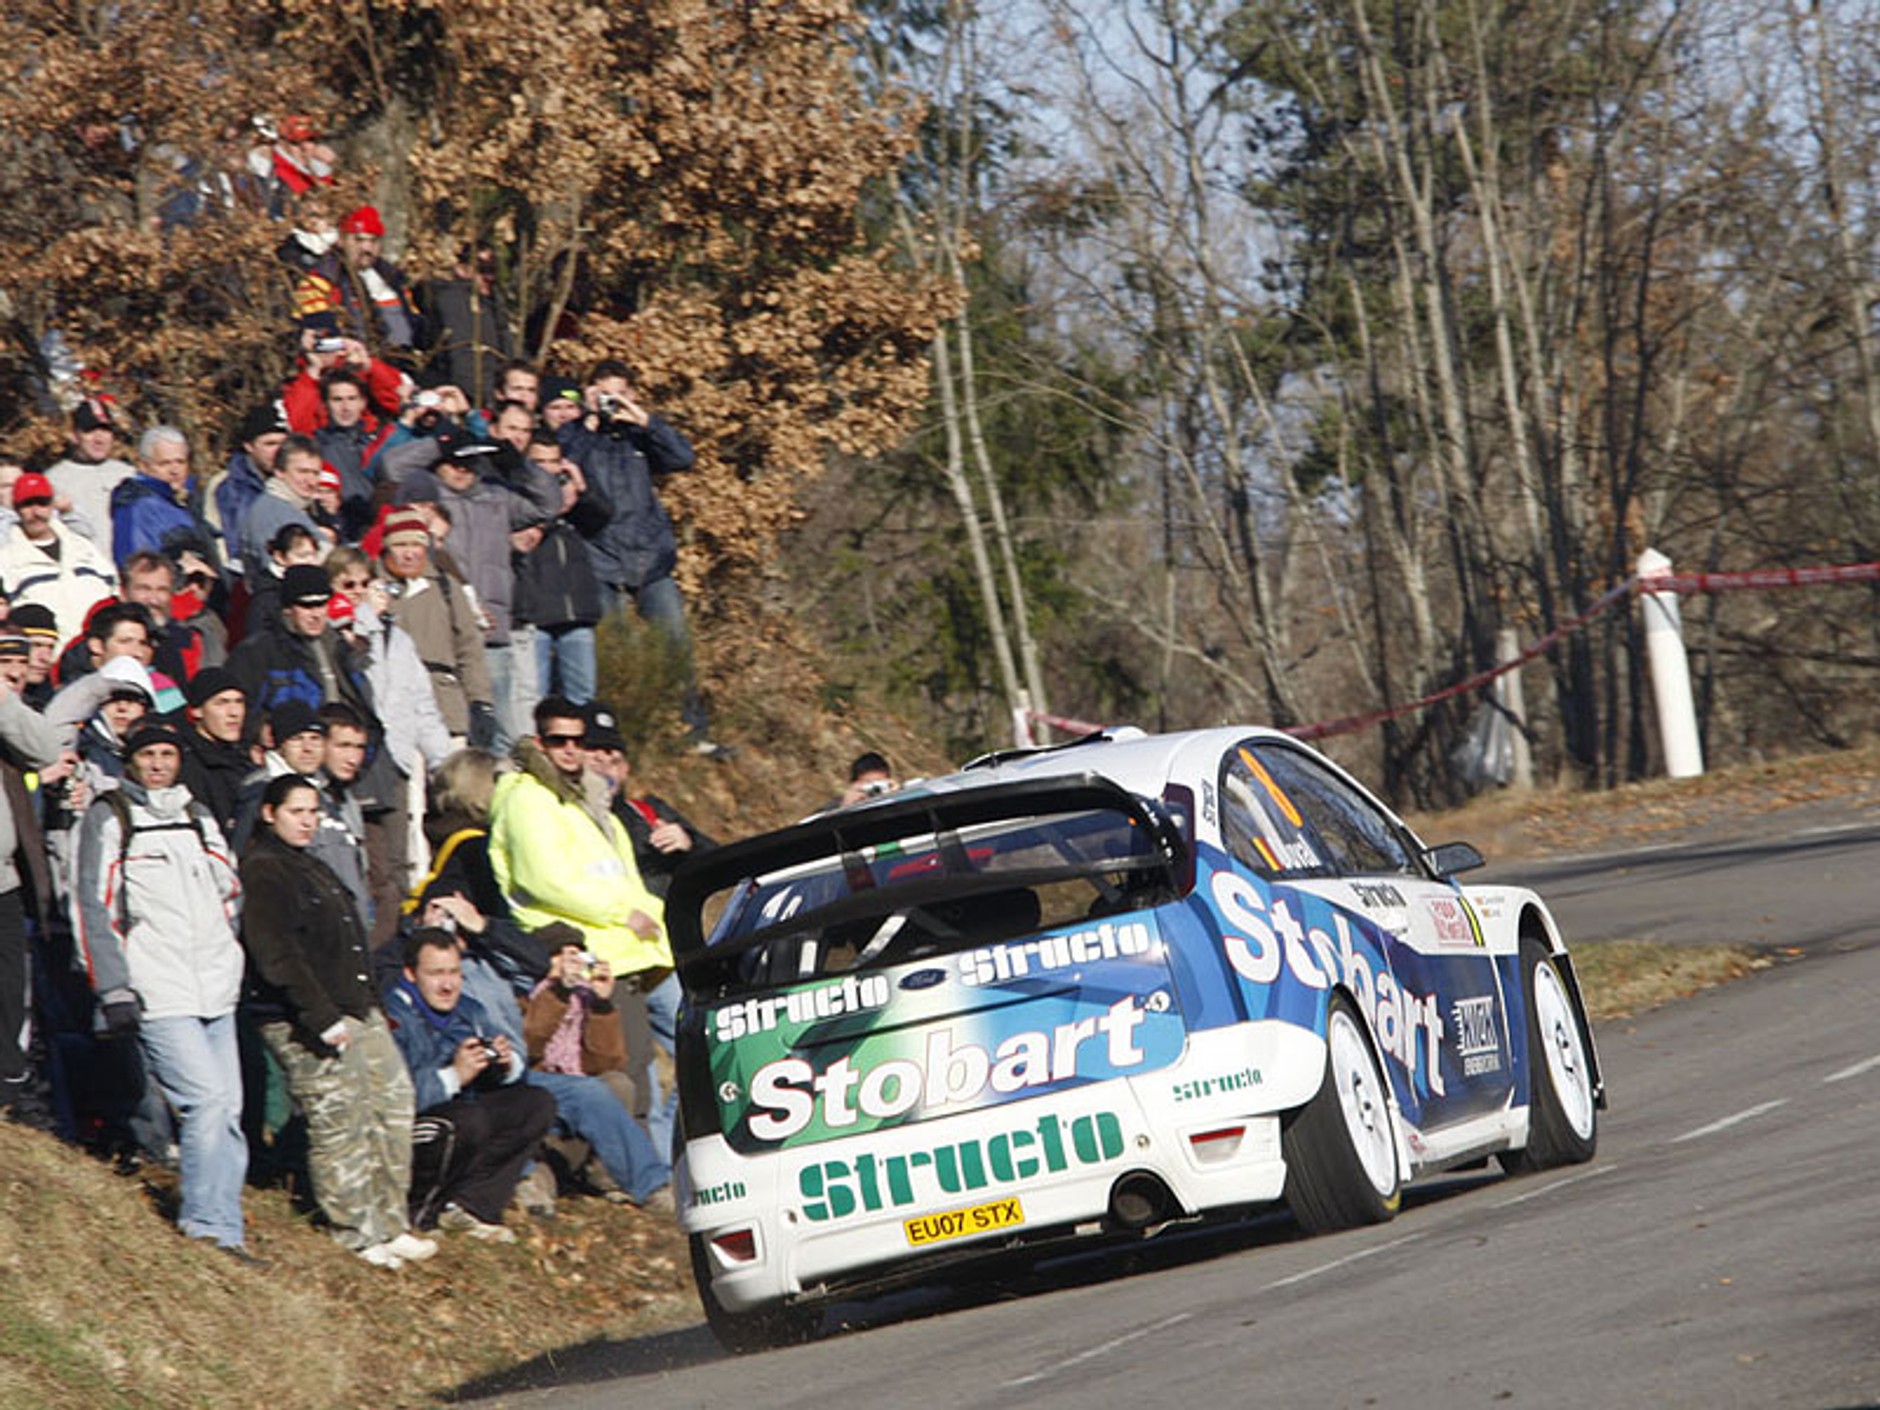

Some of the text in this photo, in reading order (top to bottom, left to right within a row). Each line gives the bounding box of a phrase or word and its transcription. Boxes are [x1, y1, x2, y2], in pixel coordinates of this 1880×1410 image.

[748, 993, 1145, 1141] Stobart
[908, 1201, 1019, 1242] EU07 STX
